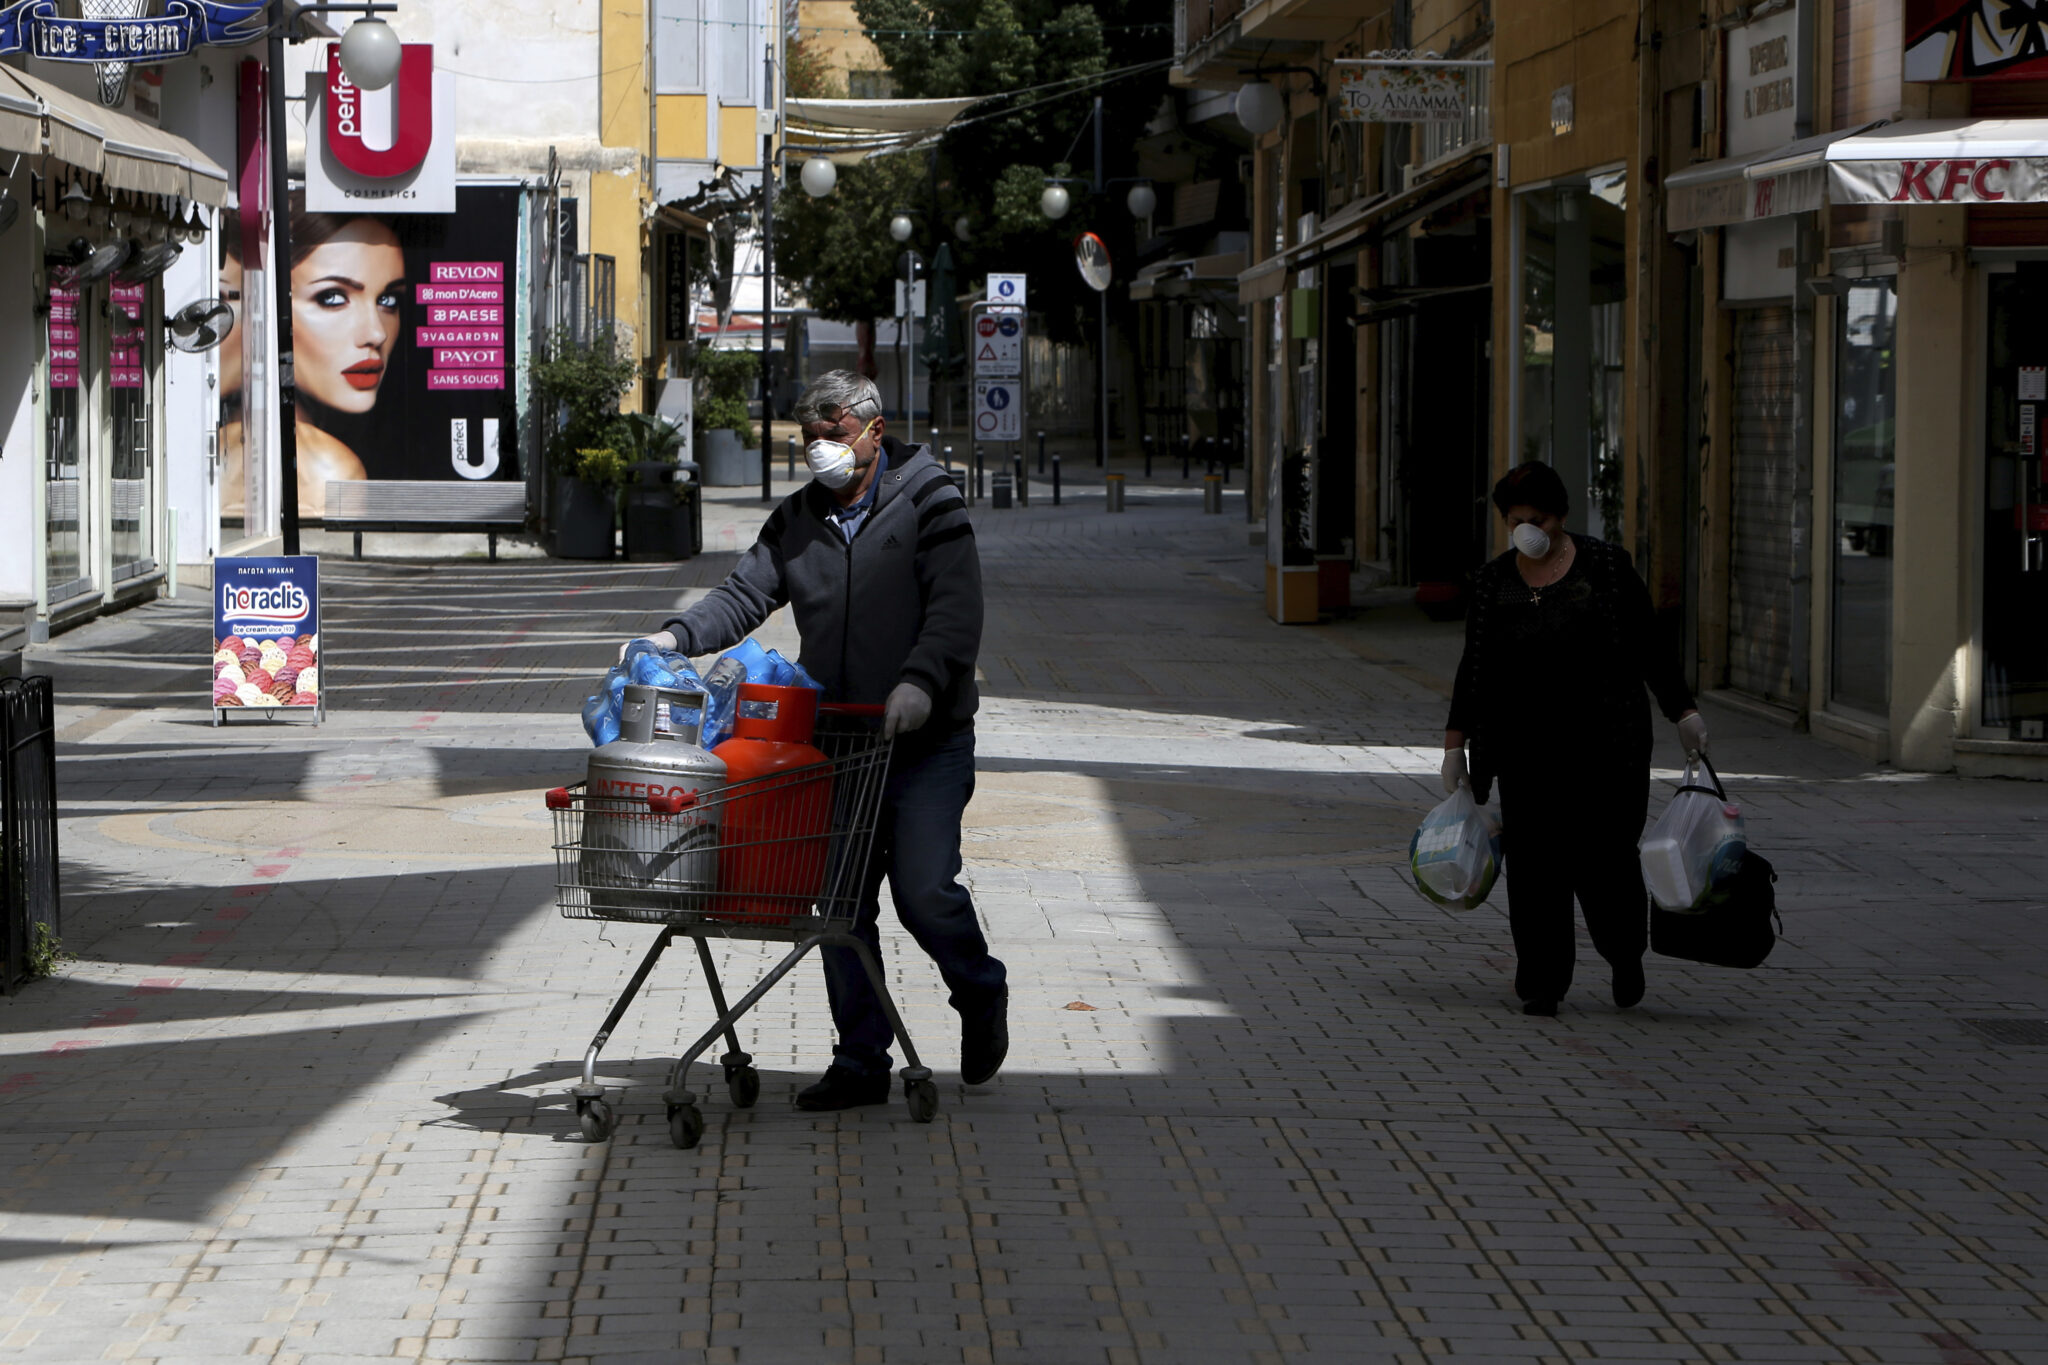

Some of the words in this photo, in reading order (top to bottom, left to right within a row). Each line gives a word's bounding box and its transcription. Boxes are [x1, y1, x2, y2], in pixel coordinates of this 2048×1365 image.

[41, 21, 77, 53] ice
[104, 24, 180, 52] cream
[331, 52, 361, 137] perfe
[1889, 159, 2011, 201] KFC
[344, 190, 417, 199] COSMETICS
[436, 266, 498, 279] REVLON
[435, 291, 458, 299] mon
[459, 289, 498, 299] D'Acero
[449, 309, 498, 321] PAESE
[440, 350, 498, 362] PAYOT
[433, 375, 460, 385] SANS
[462, 374, 499, 384] SOUCIS
[453, 421, 467, 461] perfect
[238, 567, 264, 575] ΠΑΓΩΤΑ
[267, 567, 294, 575] ΗΡΑΚΛΗ
[225, 584, 303, 610] horaclis
[233, 625, 244, 633] ice
